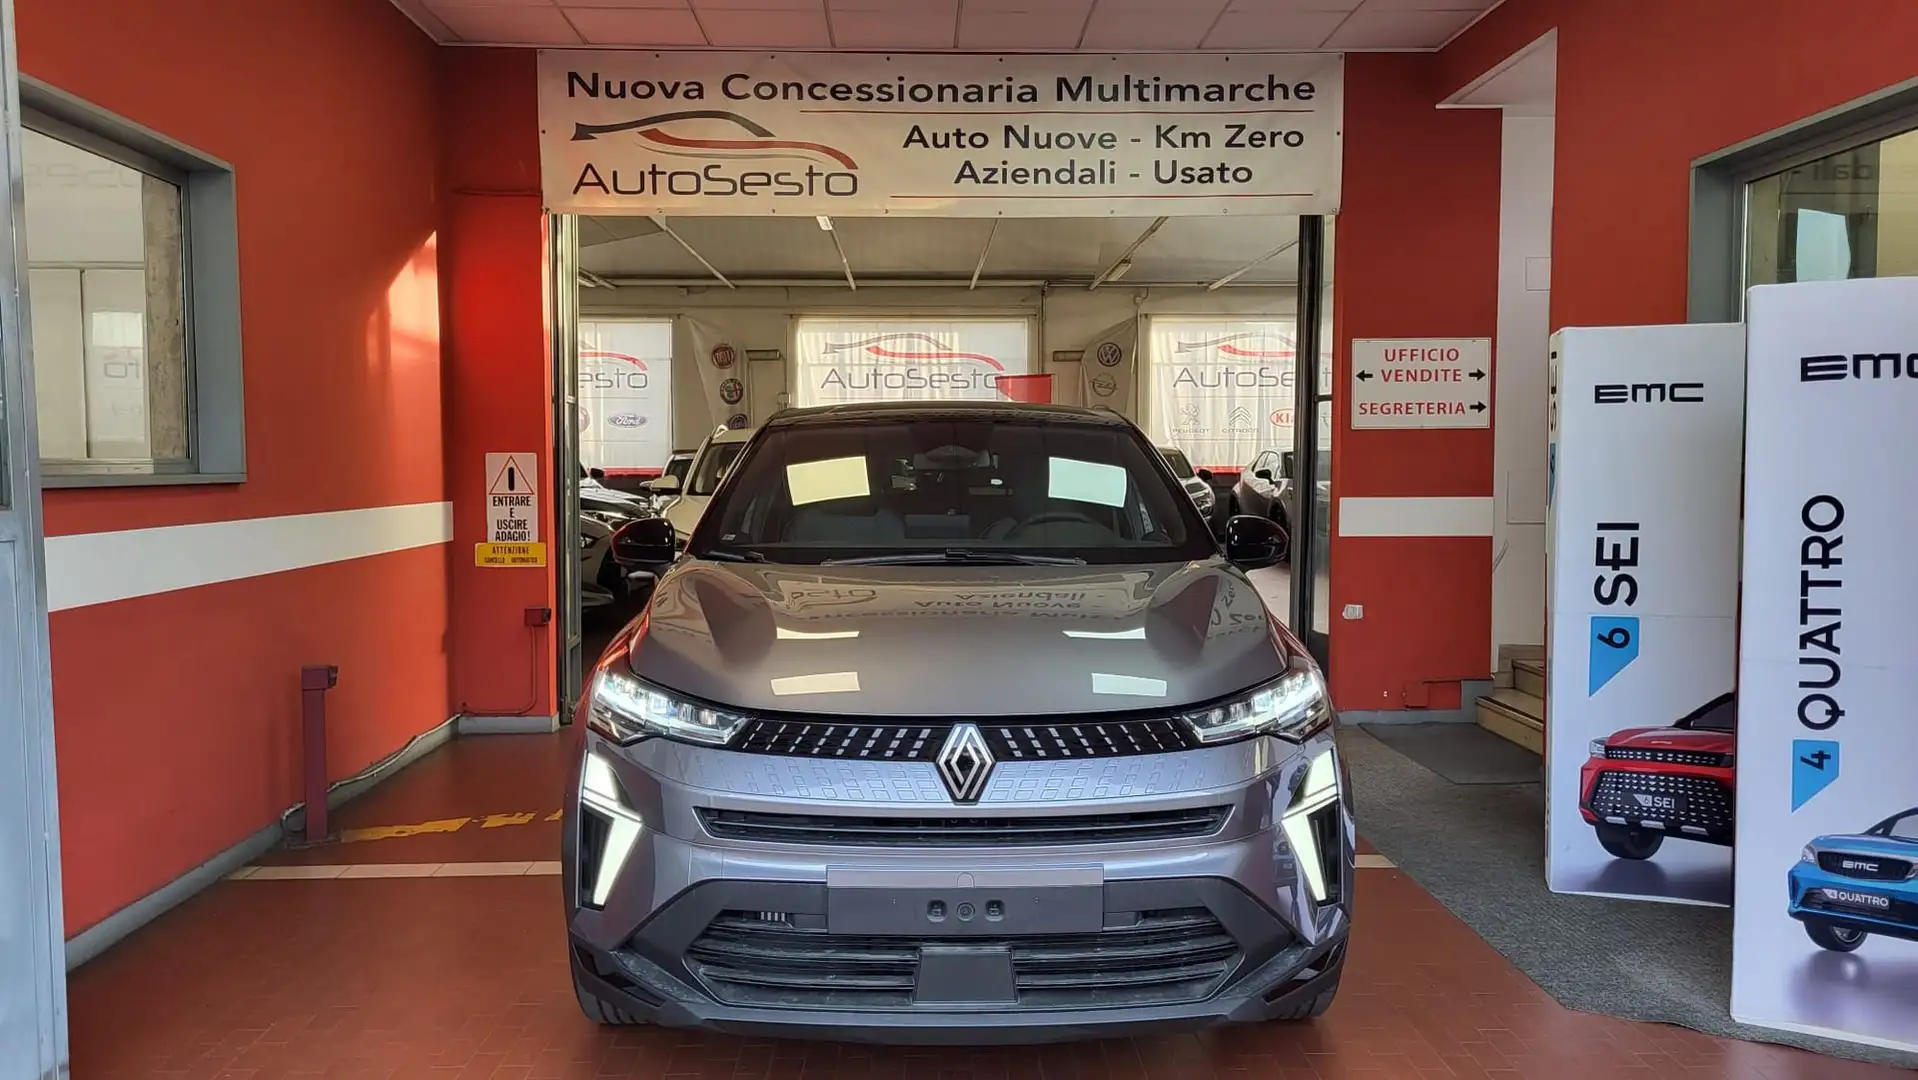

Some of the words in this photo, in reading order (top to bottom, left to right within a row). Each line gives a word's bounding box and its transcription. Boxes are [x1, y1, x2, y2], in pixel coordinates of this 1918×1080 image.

[567, 71, 704, 100] Nuova
[721, 73, 1038, 103] Concessionaria
[1056, 74, 1316, 103] Multimarche
[902, 124, 990, 149] Auto
[1003, 124, 1117, 150] Nuove
[1155, 124, 1211, 149] Km
[1224, 123, 1304, 149] Zero
[573, 163, 859, 197] AutoSesto
[953, 159, 1116, 185] Aziendali
[1154, 160, 1253, 185] Usato
[1384, 348, 1460, 362] UFFICIO
[1381, 368, 1462, 382] VENDITE
[1800, 353, 1918, 382] EM
[1594, 383, 1704, 404] EMC
[1359, 402, 1466, 415] SEGRETERIA
[492, 496, 532, 507] ENTRARE
[509, 507, 515, 518] E
[496, 519, 528, 530] USCIRE
[495, 531, 531, 541] ADAGIO!
[1593, 522, 1640, 607] SEI
[1797, 494, 1846, 731] QUATTRO
[1596, 627, 1631, 649] 6
[1800, 749, 1832, 770] 4
[1653, 797, 1675, 809] SEI
[1838, 891, 1889, 907] QUATTRO
